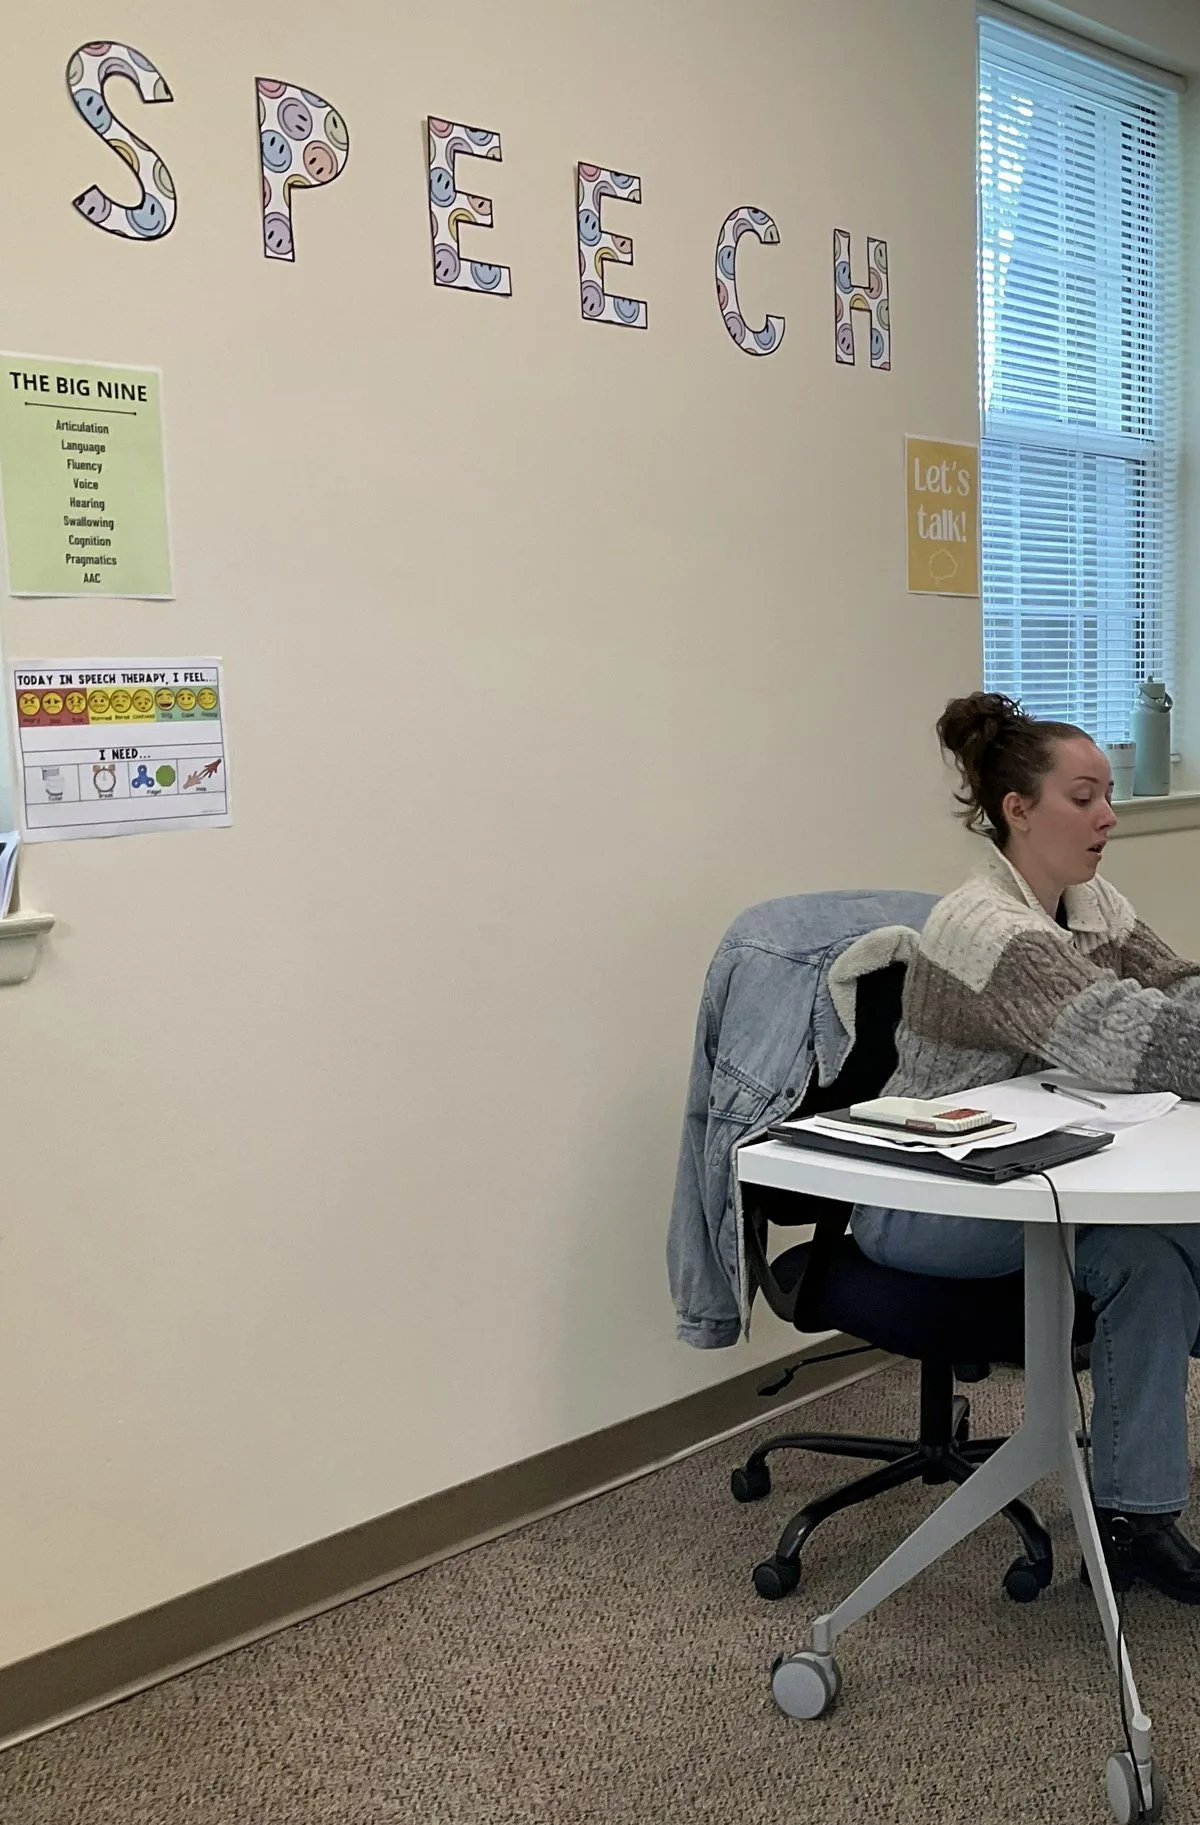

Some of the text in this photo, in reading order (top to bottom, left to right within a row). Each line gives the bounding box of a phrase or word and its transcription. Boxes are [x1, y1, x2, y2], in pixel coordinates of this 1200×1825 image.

[66, 40, 892, 371] SPEECH
[10, 372, 148, 402] THE BIG NINE
[56, 419, 109, 434] Articulation
[61, 439, 106, 454] Language
[67, 459, 102, 474] Fluency
[73, 478, 98, 490] Voice
[914, 458, 970, 496] Let's
[69, 497, 105, 512] Hearing
[63, 516, 114, 530] Swallowing
[917, 504, 967, 544] talk!
[68, 534, 111, 548] Cognition
[66, 554, 117, 567] Pragmatics
[84, 572, 100, 584] AAC
[18, 674, 54, 686] TODAY
[59, 674, 73, 684] IN
[78, 674, 116, 684] SPEECH
[121, 672, 169, 685] THERAPY,
[173, 672, 180, 682] I
[100, 750, 106, 760] I
